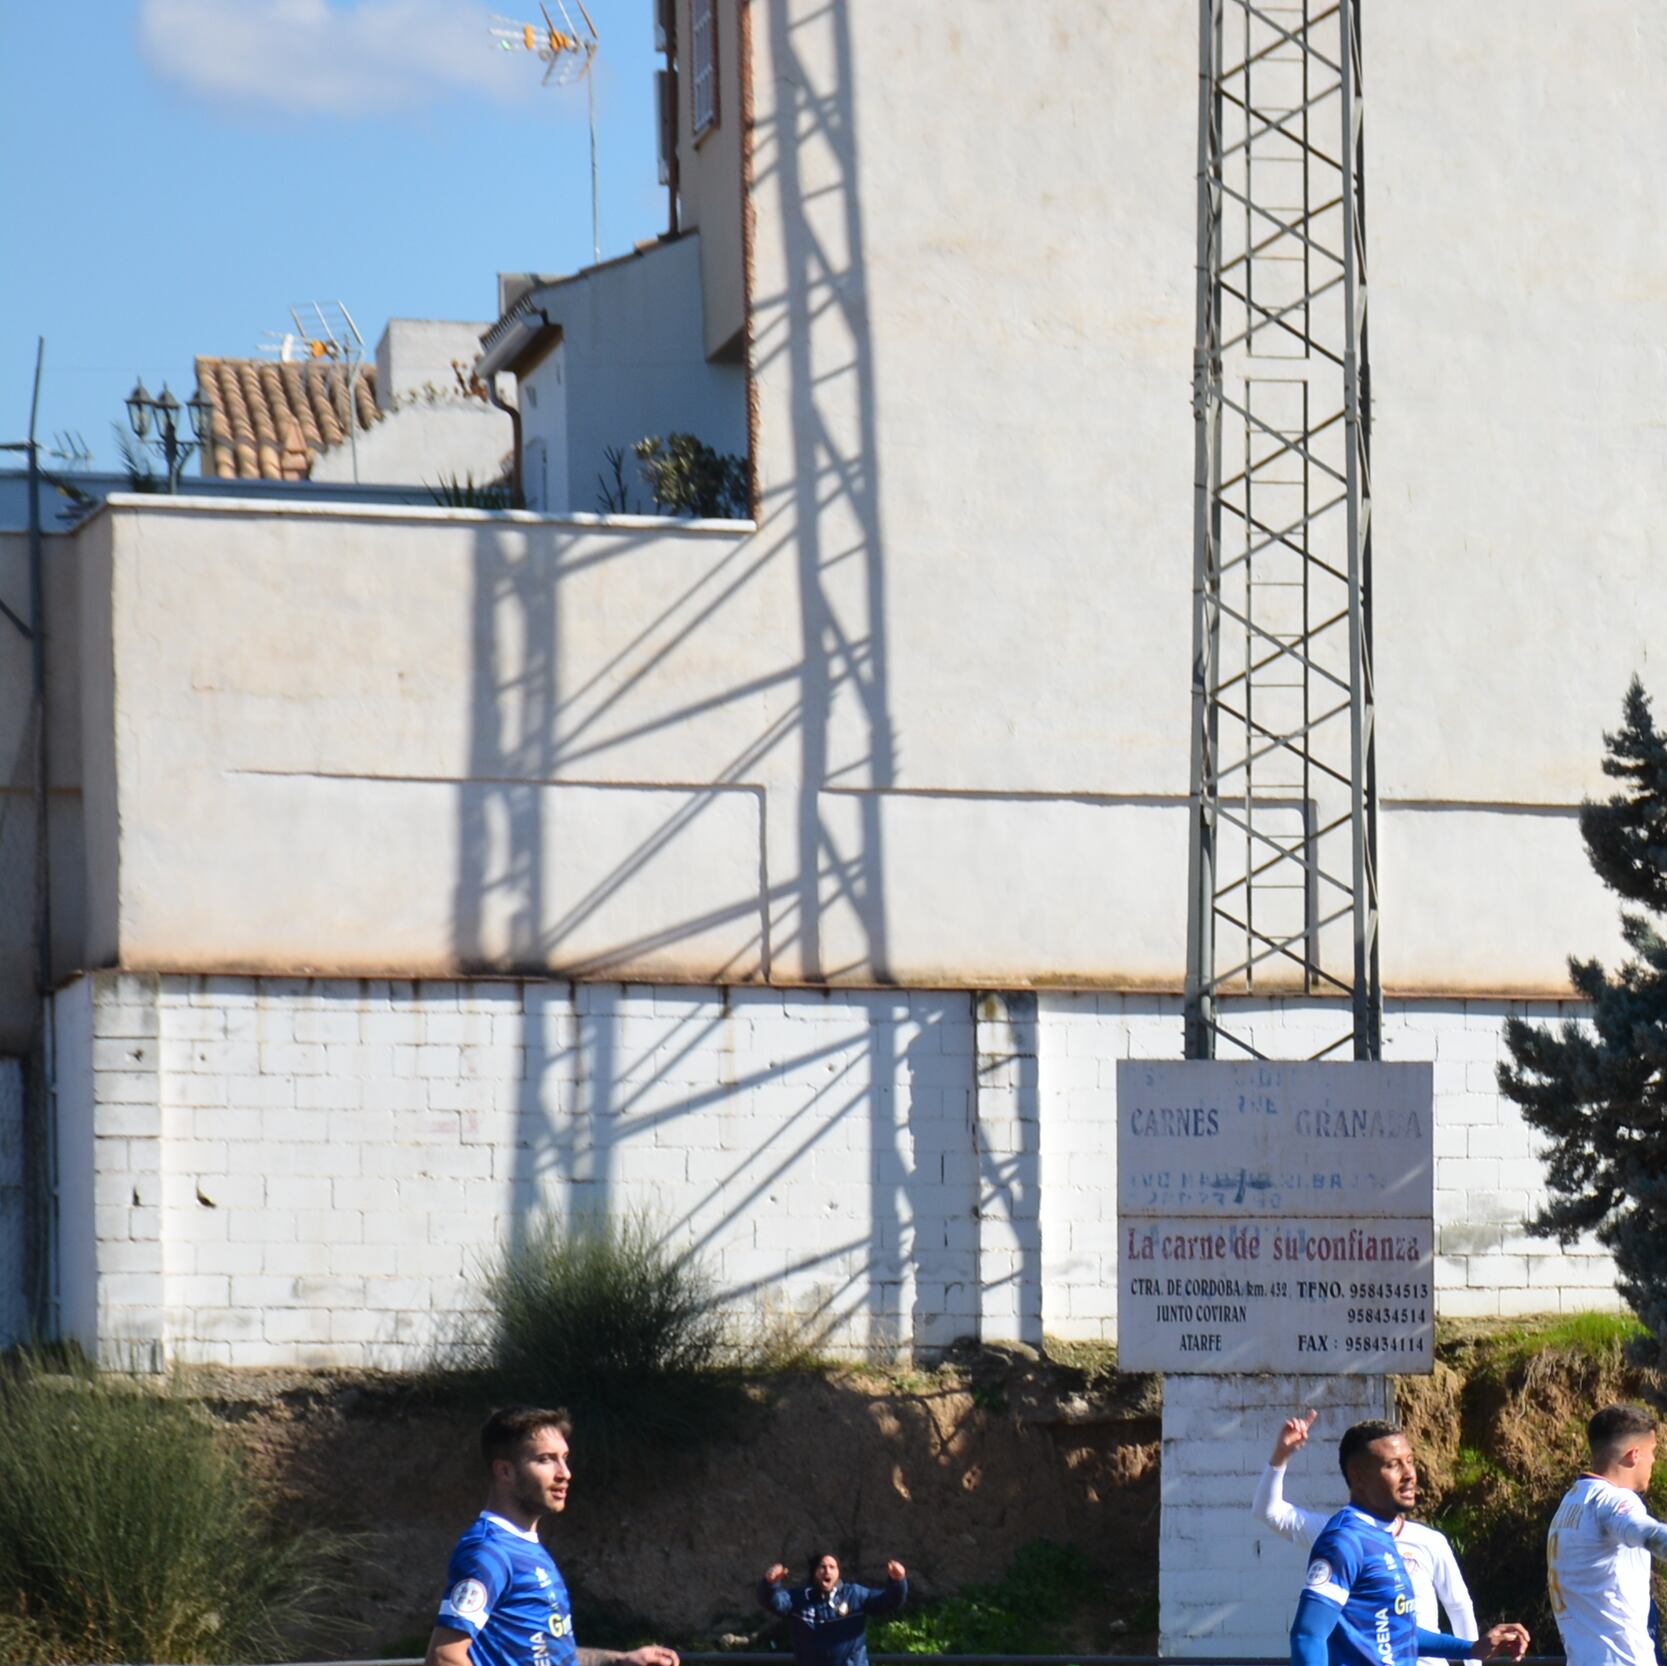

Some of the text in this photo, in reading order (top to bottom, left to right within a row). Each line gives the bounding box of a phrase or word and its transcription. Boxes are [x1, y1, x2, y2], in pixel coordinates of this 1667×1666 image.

[1131, 1108, 1421, 1138] CARNES GRANADA
[1127, 1226, 1420, 1262] La carne de su confianza
[1130, 1278, 1164, 1297] CTRA.
[1167, 1278, 1182, 1297] DE
[1270, 1282, 1288, 1298] 432
[1350, 1283, 1429, 1299] 958434513
[1156, 1304, 1247, 1323] JUNTO COVIRAN
[1347, 1308, 1426, 1324] 958434514
[1179, 1333, 1222, 1352] ATARFE
[1297, 1334, 1329, 1352] FAX
[1345, 1336, 1424, 1352] 958434114
